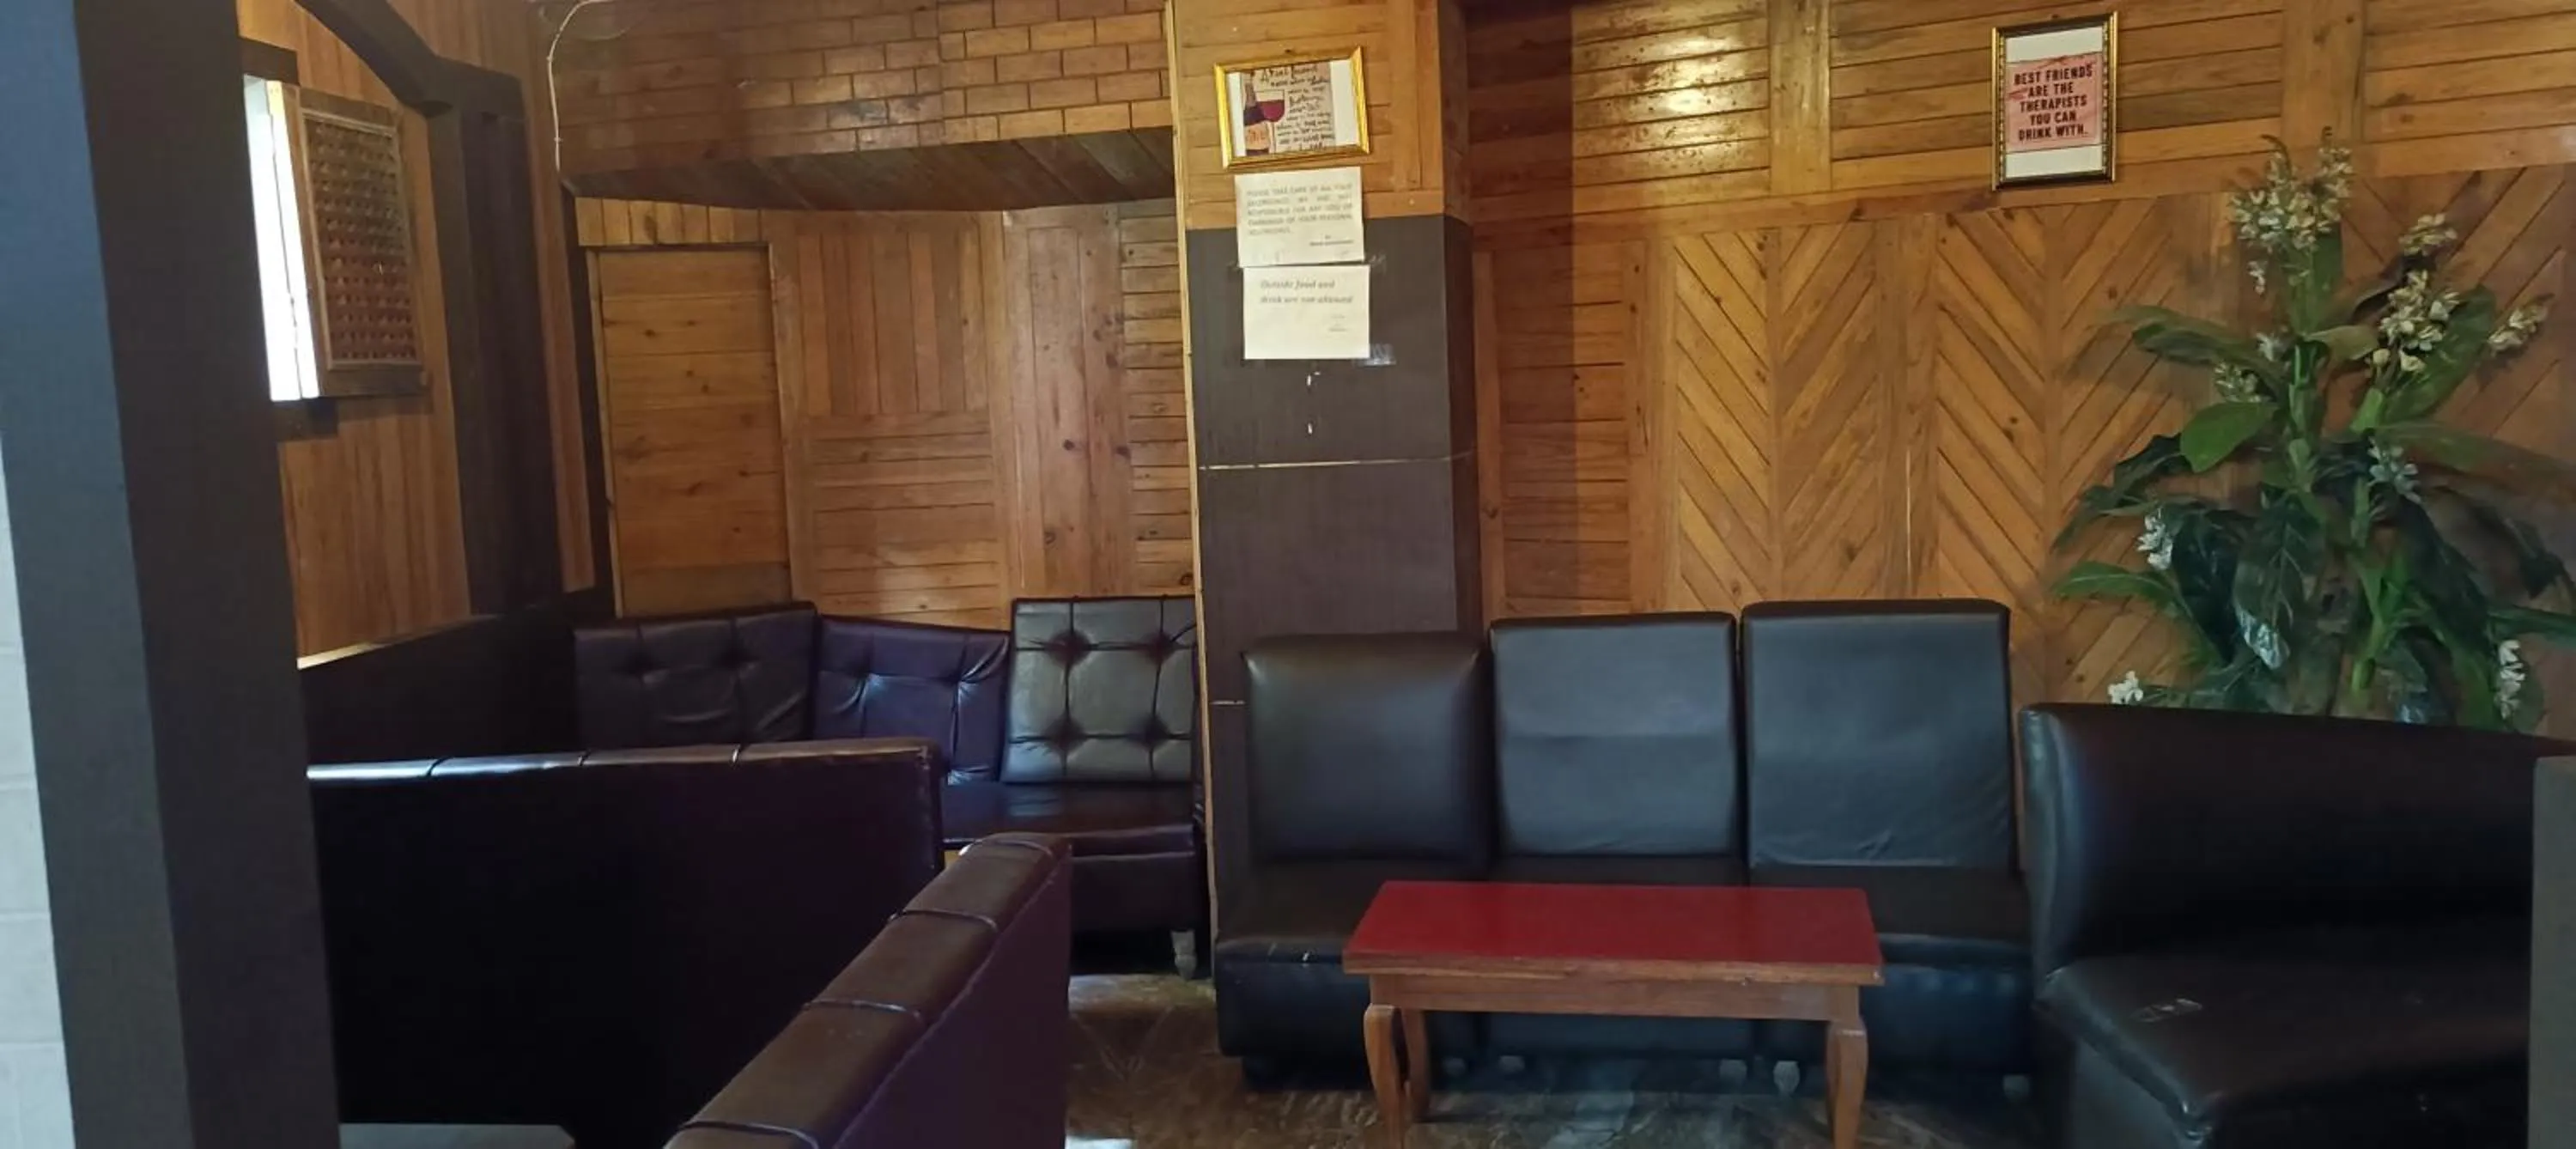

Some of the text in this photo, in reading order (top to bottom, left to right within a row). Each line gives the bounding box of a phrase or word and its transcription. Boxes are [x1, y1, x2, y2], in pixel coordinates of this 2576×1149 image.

[2014, 64, 2093, 85] BEST FRIENDS
[2027, 82, 2074, 97] ARE THE
[2020, 94, 2087, 112] THERAPISTS
[2030, 111, 2076, 125] YOU CAN
[2019, 127, 2052, 141] DRINK
